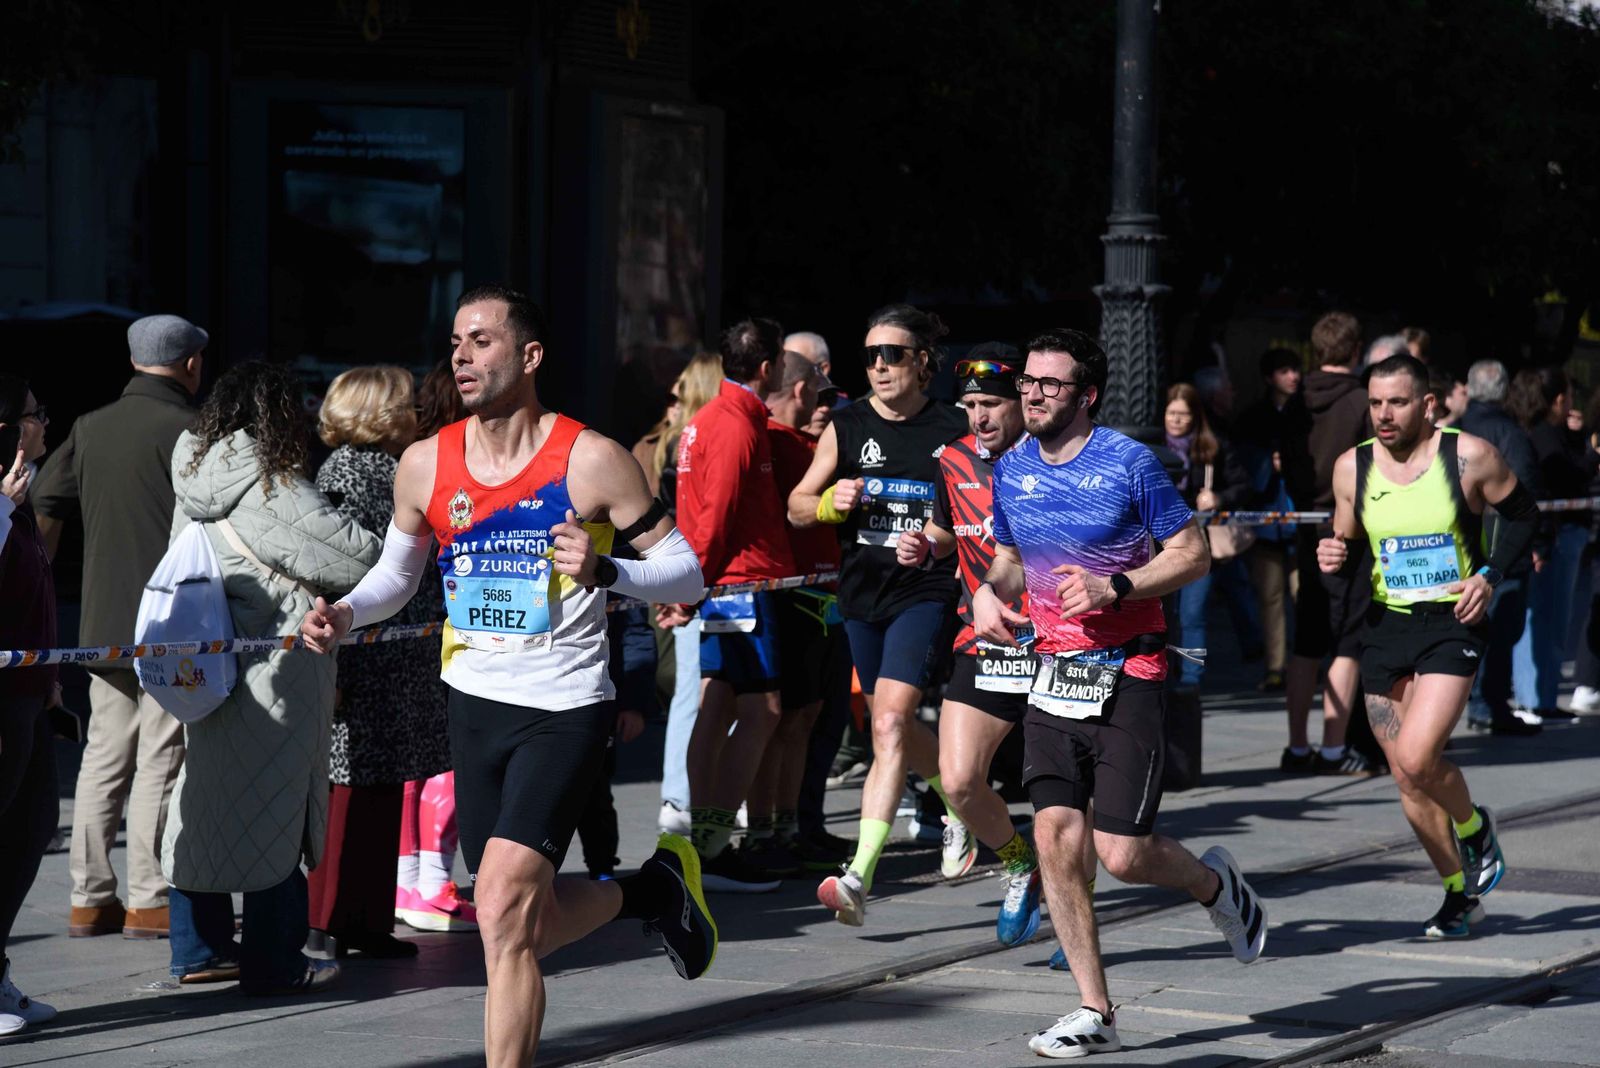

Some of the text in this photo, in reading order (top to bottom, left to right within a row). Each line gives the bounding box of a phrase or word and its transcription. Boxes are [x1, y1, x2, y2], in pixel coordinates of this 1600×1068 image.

[888, 483, 928, 495] ZURICH
[869, 515, 923, 533] CARLOS
[507, 530, 547, 538] ATLETISMO
[451, 539, 548, 556] PALACIEGO
[1401, 535, 1444, 549] ZURICH
[480, 559, 538, 575] ZURICH
[1406, 557, 1429, 568] 5625
[1384, 575, 1409, 588] POR
[1411, 573, 1423, 585] TI
[483, 588, 512, 603] 5685
[468, 603, 527, 630] PÉREZ
[1003, 646, 1028, 657] 5034
[1066, 666, 1088, 680] 5314
[1050, 681, 1114, 701] EXANDRE
